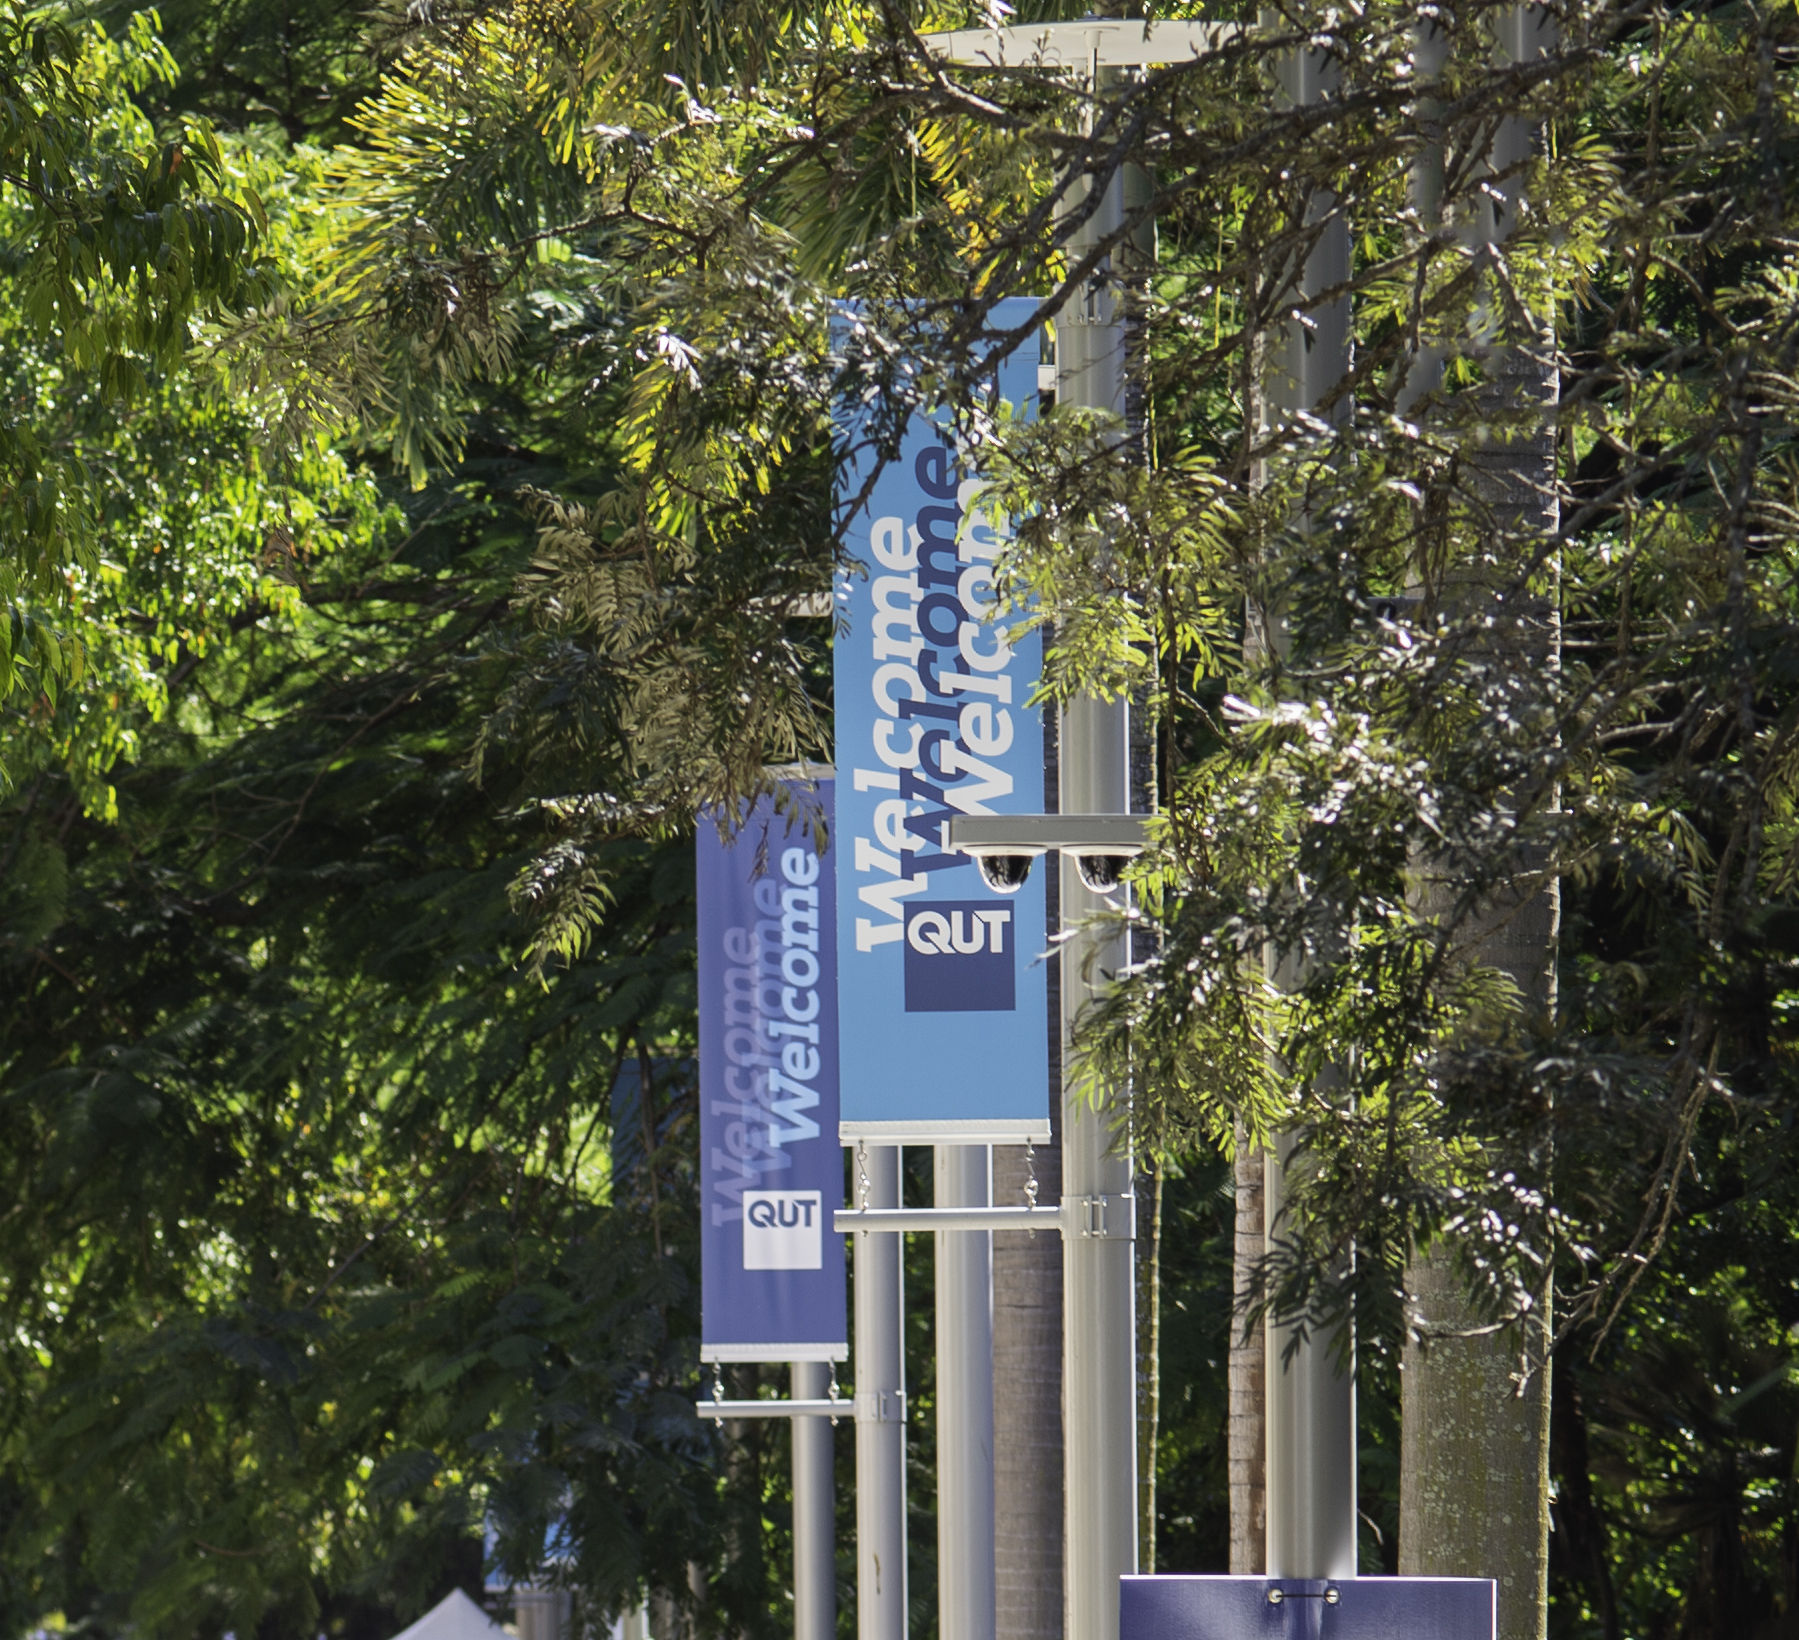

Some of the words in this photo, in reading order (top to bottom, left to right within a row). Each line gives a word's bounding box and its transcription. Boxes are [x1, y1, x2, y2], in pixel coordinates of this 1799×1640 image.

[854, 516, 928, 952] Welcome
[768, 847, 820, 1149] Welcome
[907, 909, 1011, 956] QUT
[747, 1199, 817, 1229] QUT
